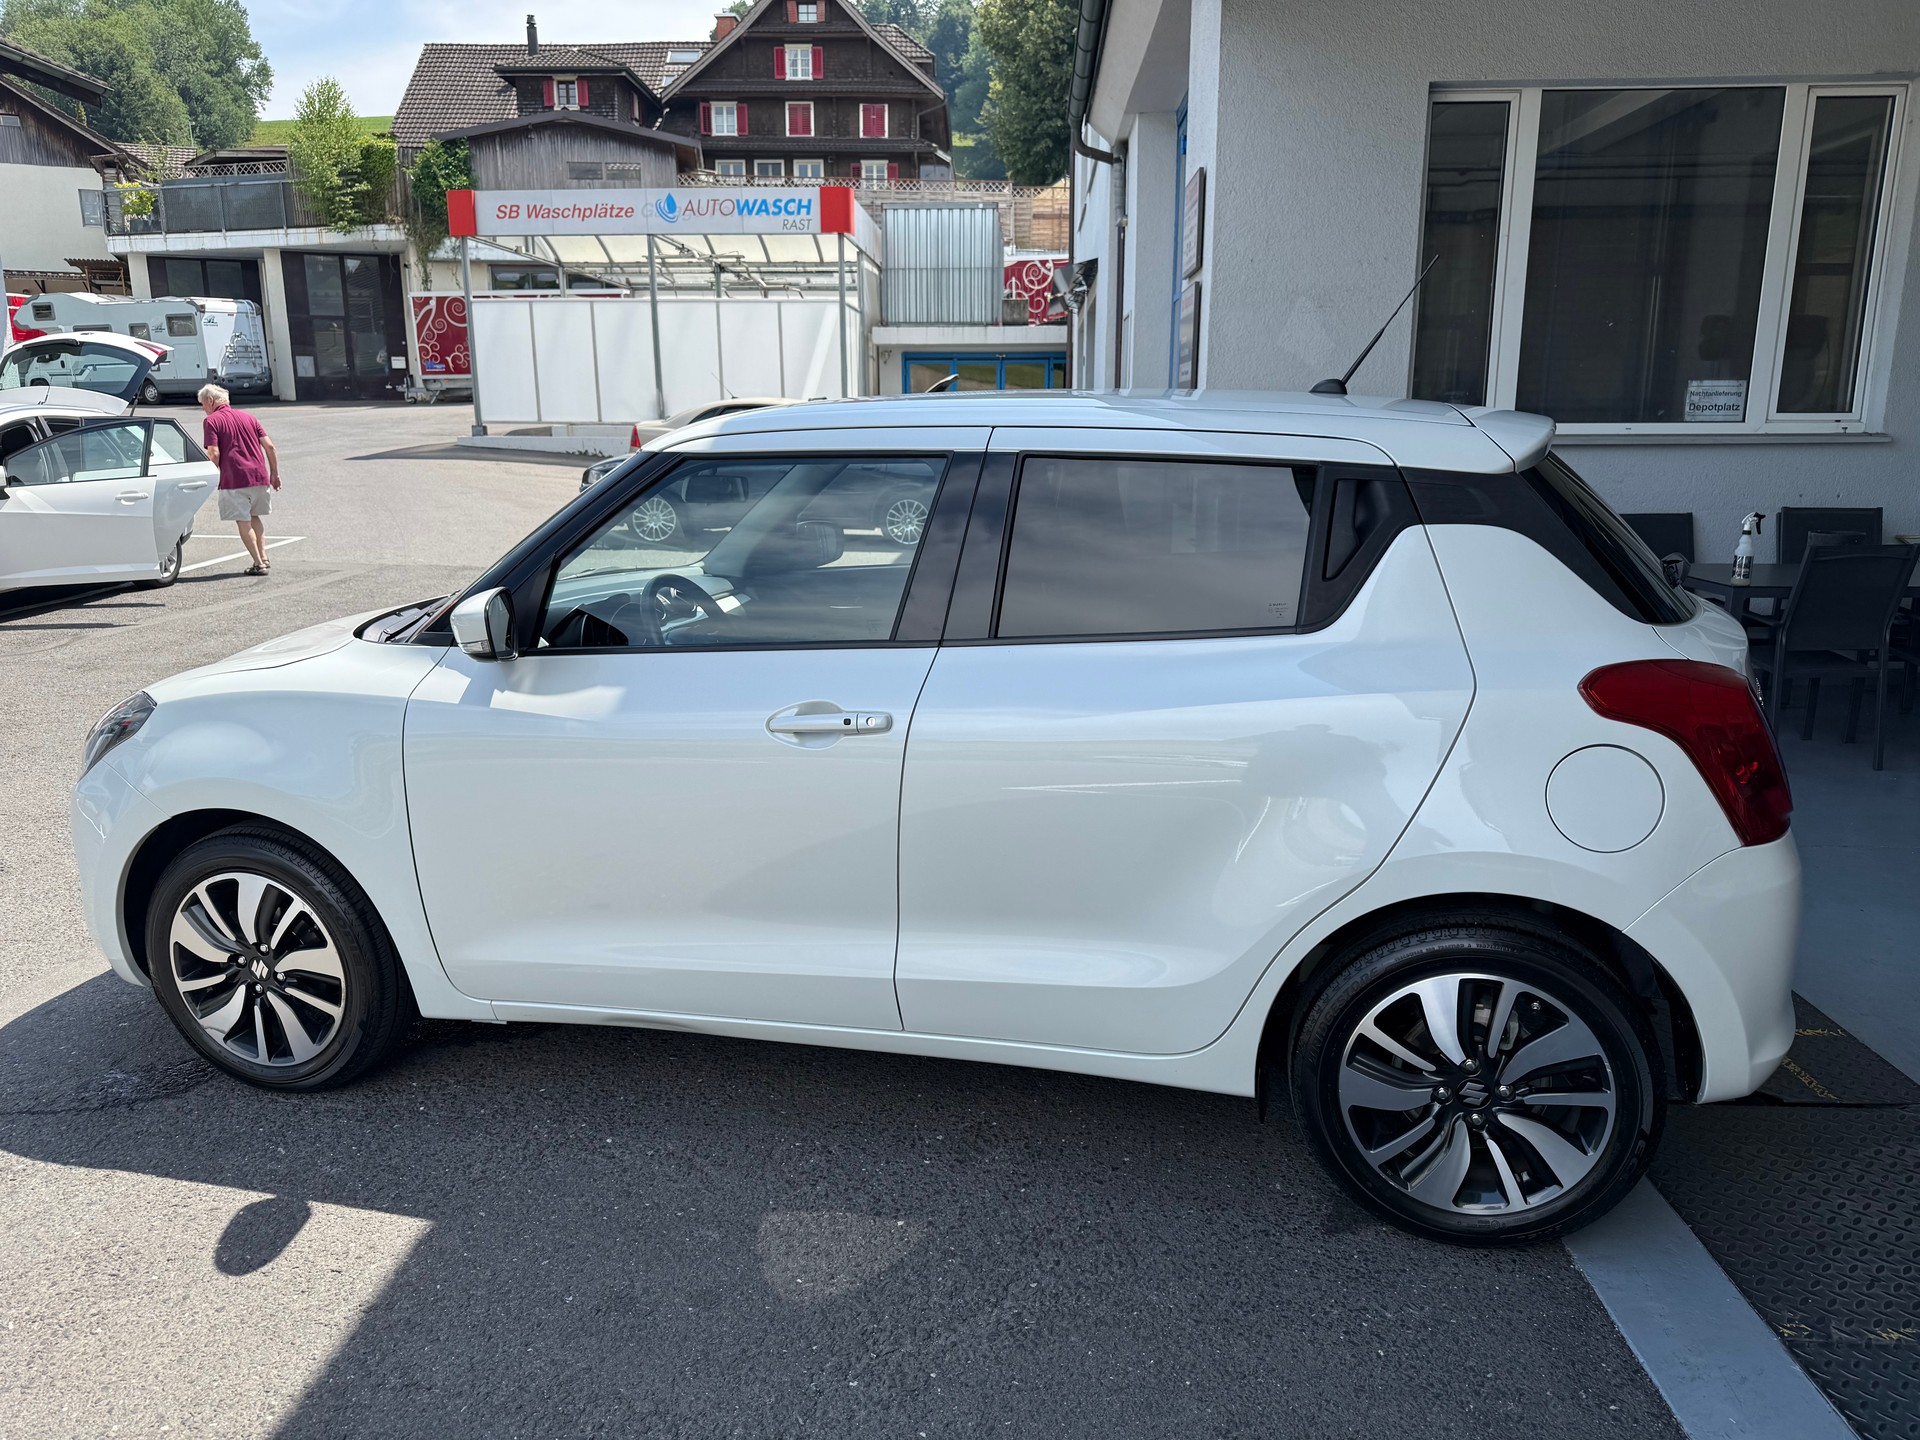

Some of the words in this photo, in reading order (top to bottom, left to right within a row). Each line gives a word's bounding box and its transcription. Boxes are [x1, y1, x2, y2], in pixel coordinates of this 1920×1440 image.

[496, 204, 521, 219] SB
[526, 203, 635, 222] Waschplätze
[682, 198, 812, 217] AUTOWASCH
[782, 218, 812, 231] RAST
[1689, 402, 1740, 413] Depotplatz
